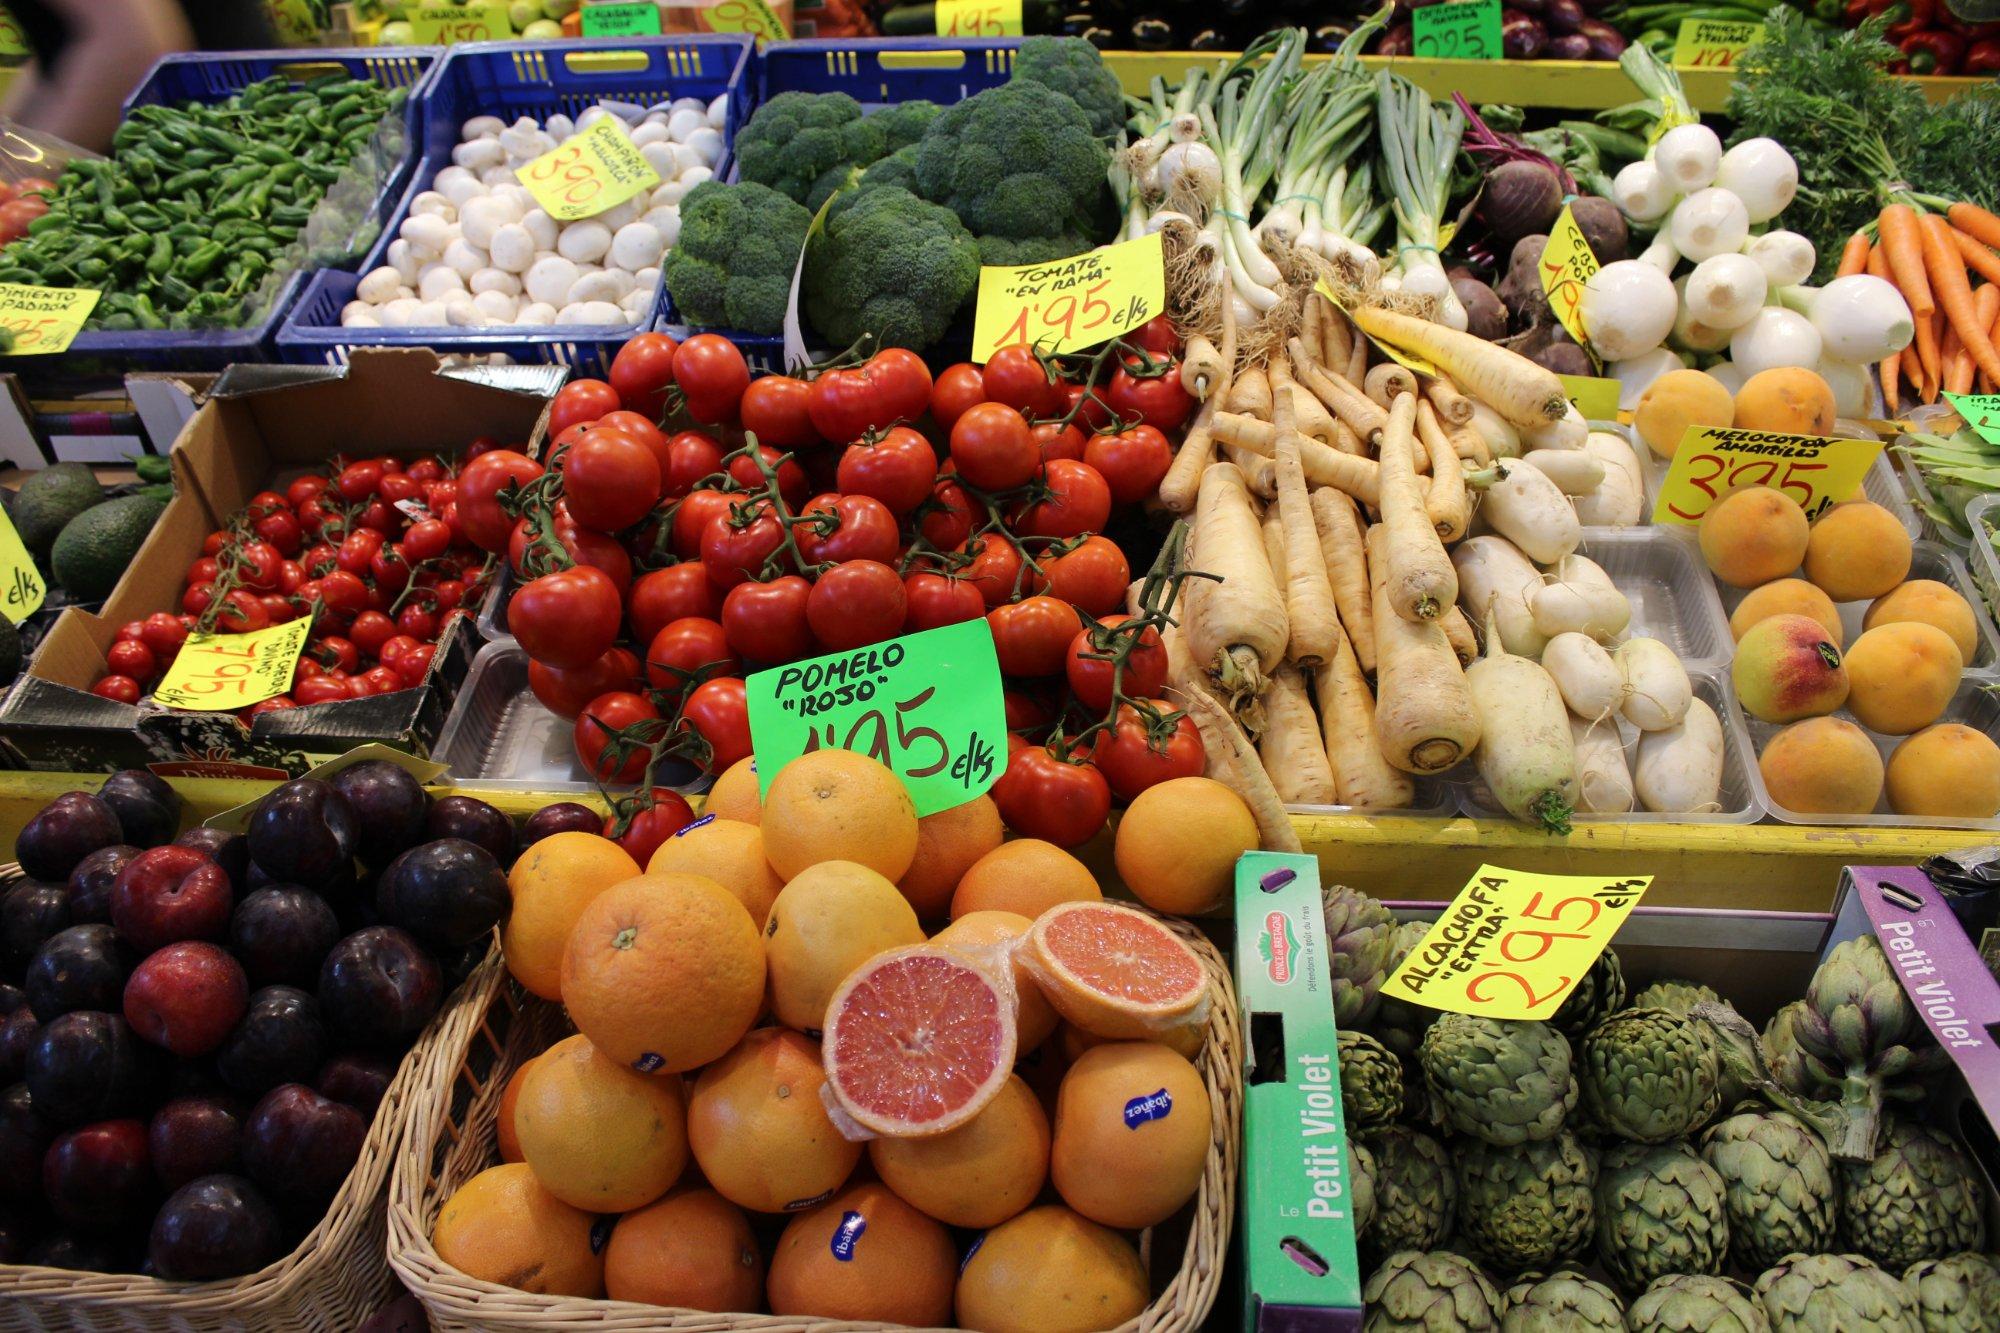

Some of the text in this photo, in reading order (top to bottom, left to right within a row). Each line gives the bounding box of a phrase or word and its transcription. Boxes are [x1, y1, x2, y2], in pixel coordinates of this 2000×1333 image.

[1014, 254, 1104, 283] TOMATE
[775, 643, 905, 699] POMELO
[1400, 876, 1509, 994] ALCACHOFA
[1465, 891, 1602, 1010] 2'95
[1916, 918, 1936, 929] Le
[1880, 921, 1983, 1049] Petit Violet
[1298, 1054, 1345, 1219] Petit Violet
[1280, 1205, 1300, 1218] Le
